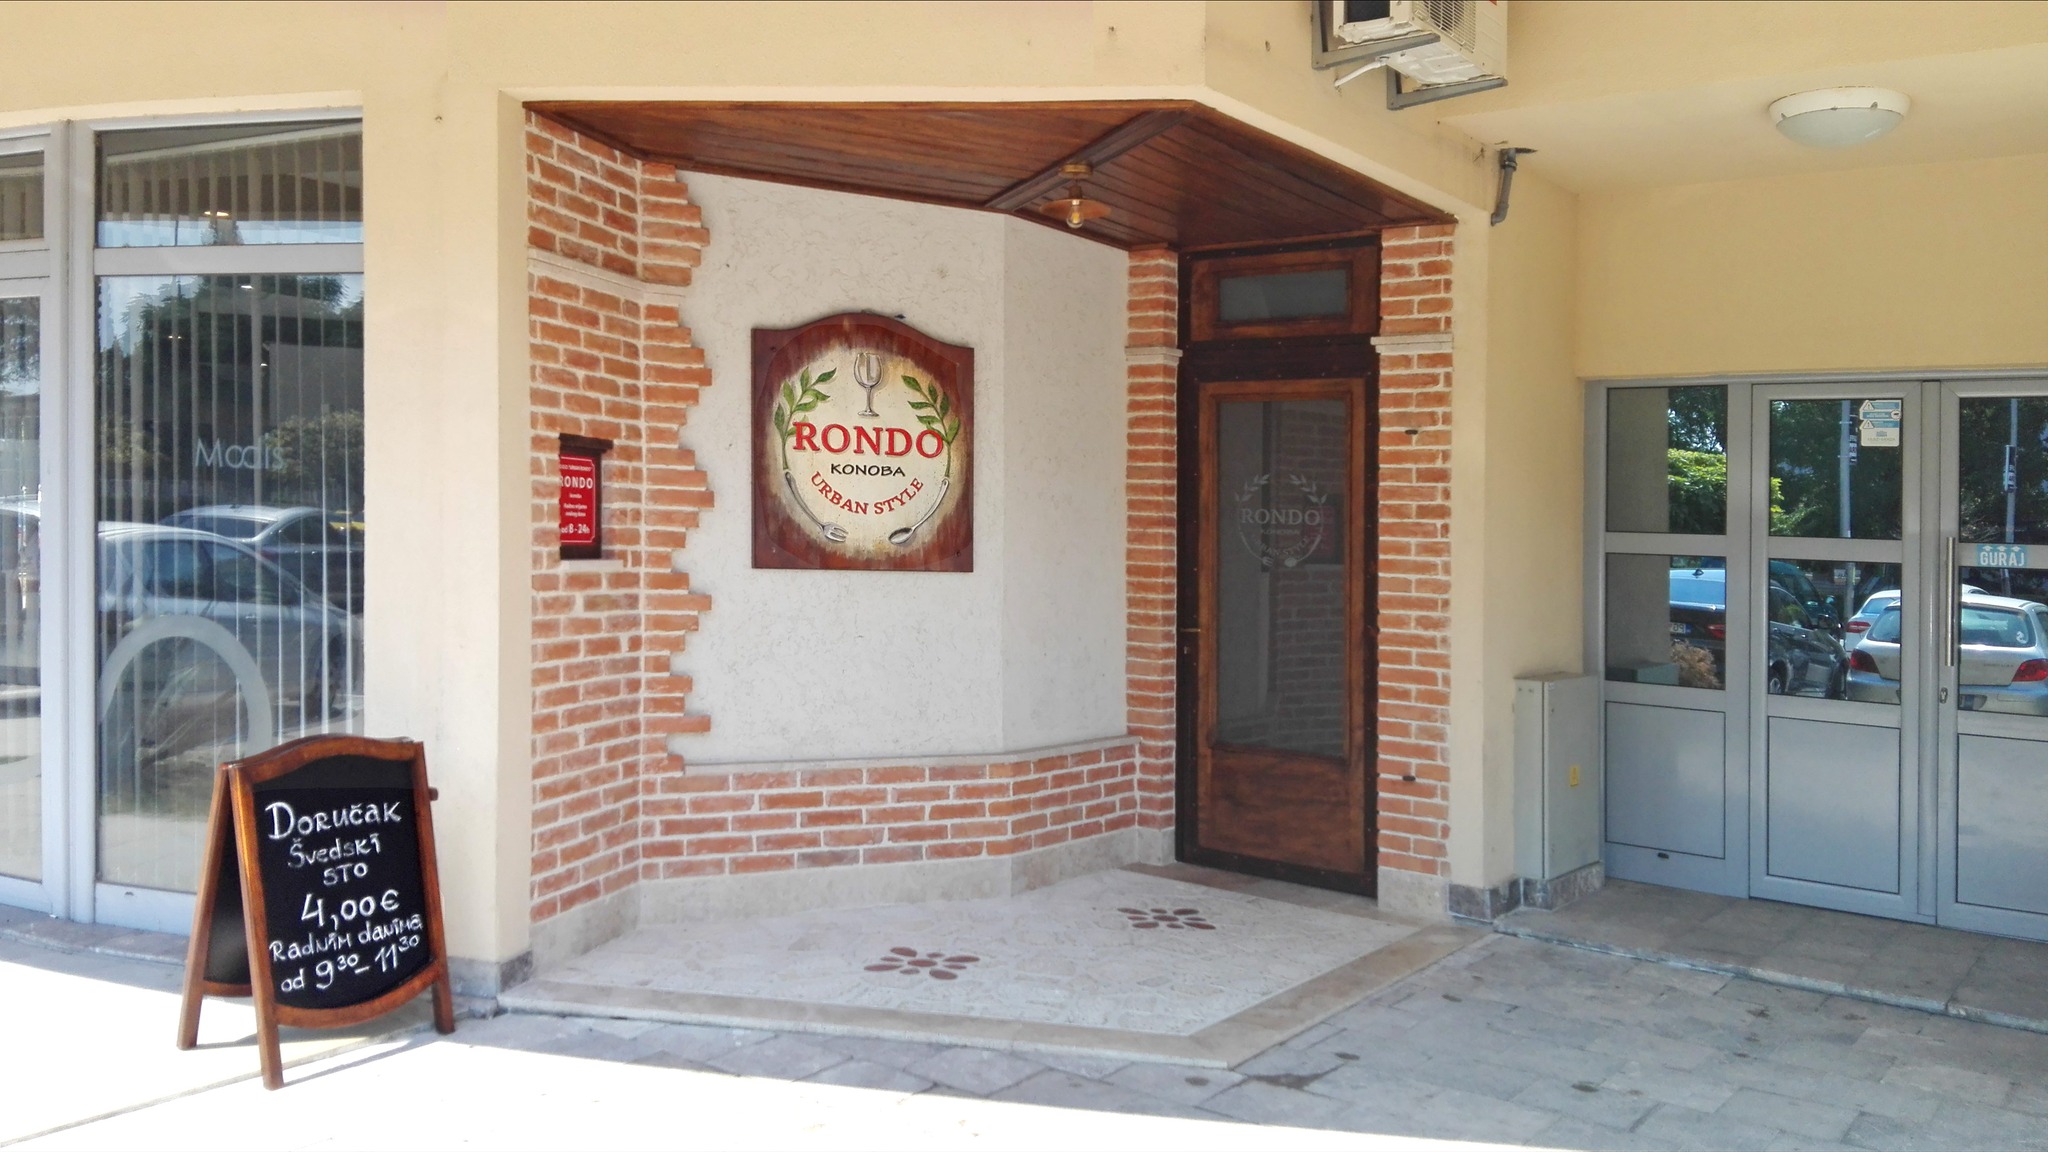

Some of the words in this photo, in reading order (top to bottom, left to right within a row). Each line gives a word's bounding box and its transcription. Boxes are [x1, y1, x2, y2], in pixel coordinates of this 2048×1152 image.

[792, 421, 944, 459] RONDO
[830, 463, 906, 477] KONOBA
[811, 472, 869, 515] URBAN
[873, 478, 924, 515] STYLE
[1241, 508, 1320, 526] RONDO
[1980, 551, 2025, 567] GURAJ
[269, 932, 352, 962] Radnim
[358, 914, 423, 944] danima
[281, 968, 304, 992] od
